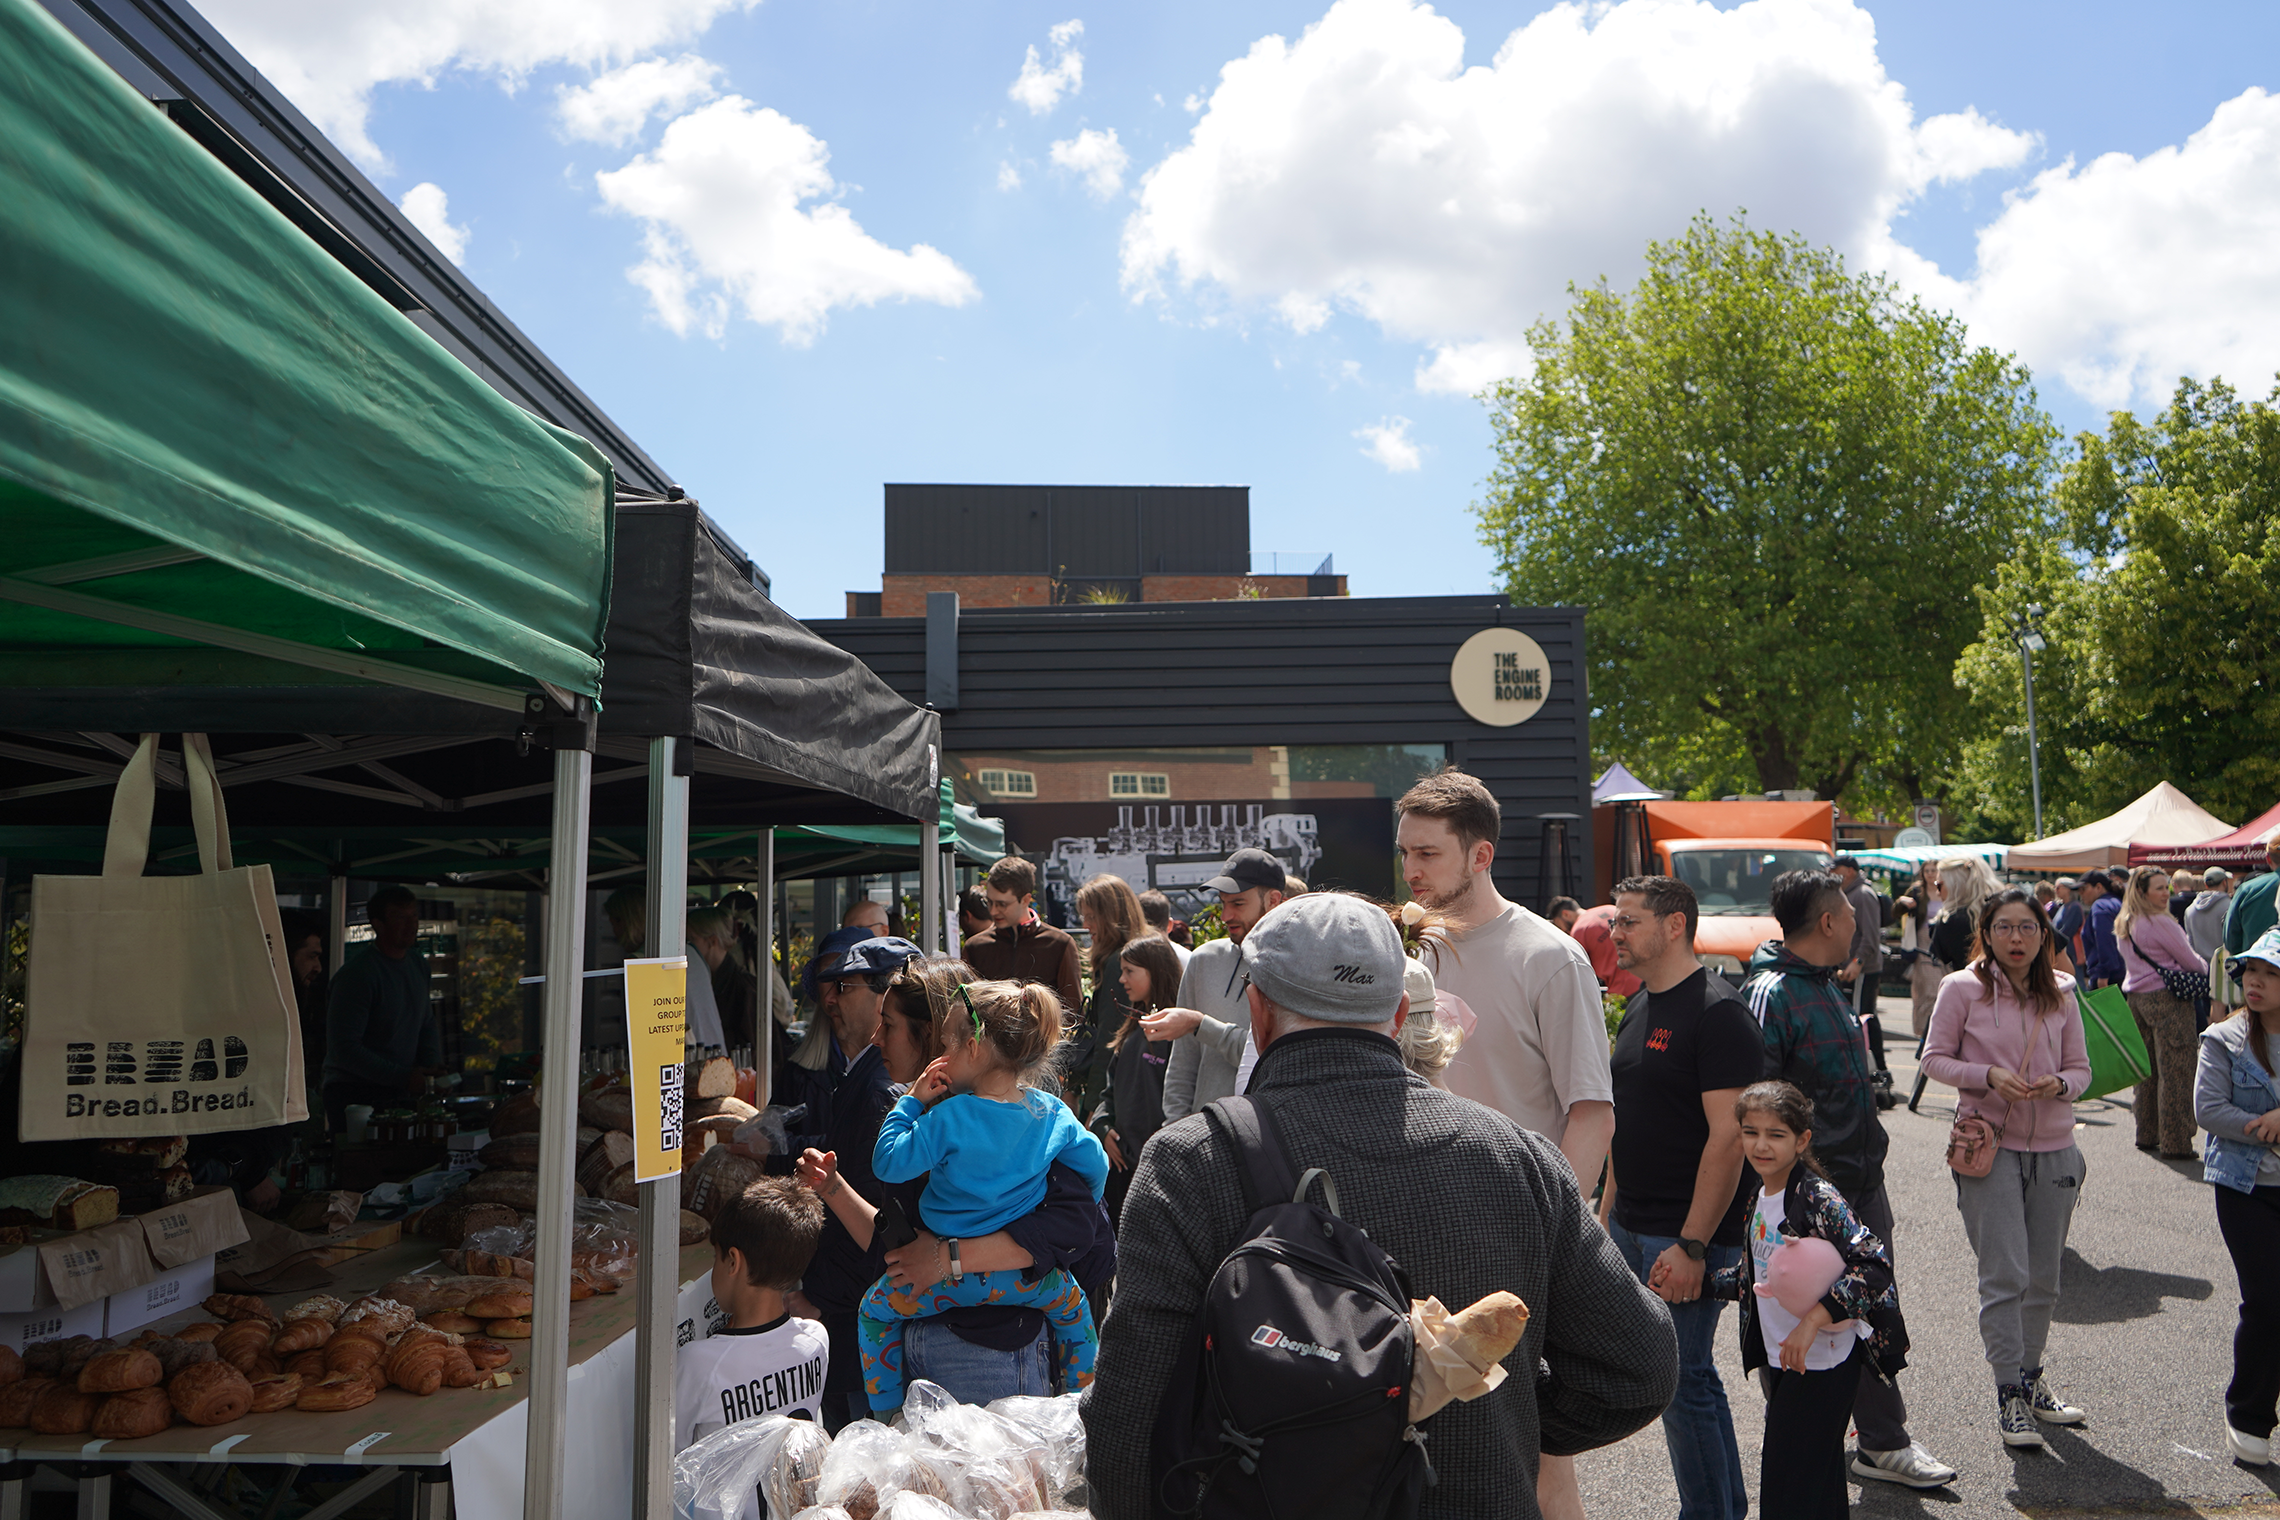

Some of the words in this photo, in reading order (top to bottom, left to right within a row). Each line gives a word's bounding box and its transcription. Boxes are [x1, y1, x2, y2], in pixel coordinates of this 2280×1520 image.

[1494, 652, 1518, 667] THE
[1495, 668, 1541, 684] ENGINE
[1495, 685, 1542, 700] ROOMS
[1333, 964, 1375, 985] Max
[653, 997, 671, 1006] JOIN
[657, 1010, 682, 1019] GROUP
[648, 1025, 673, 1034] LATEST
[66, 1036, 248, 1086] BREAD
[1278, 1335, 1342, 1362] berghaus
[720, 1355, 822, 1426] ARGENTINA
